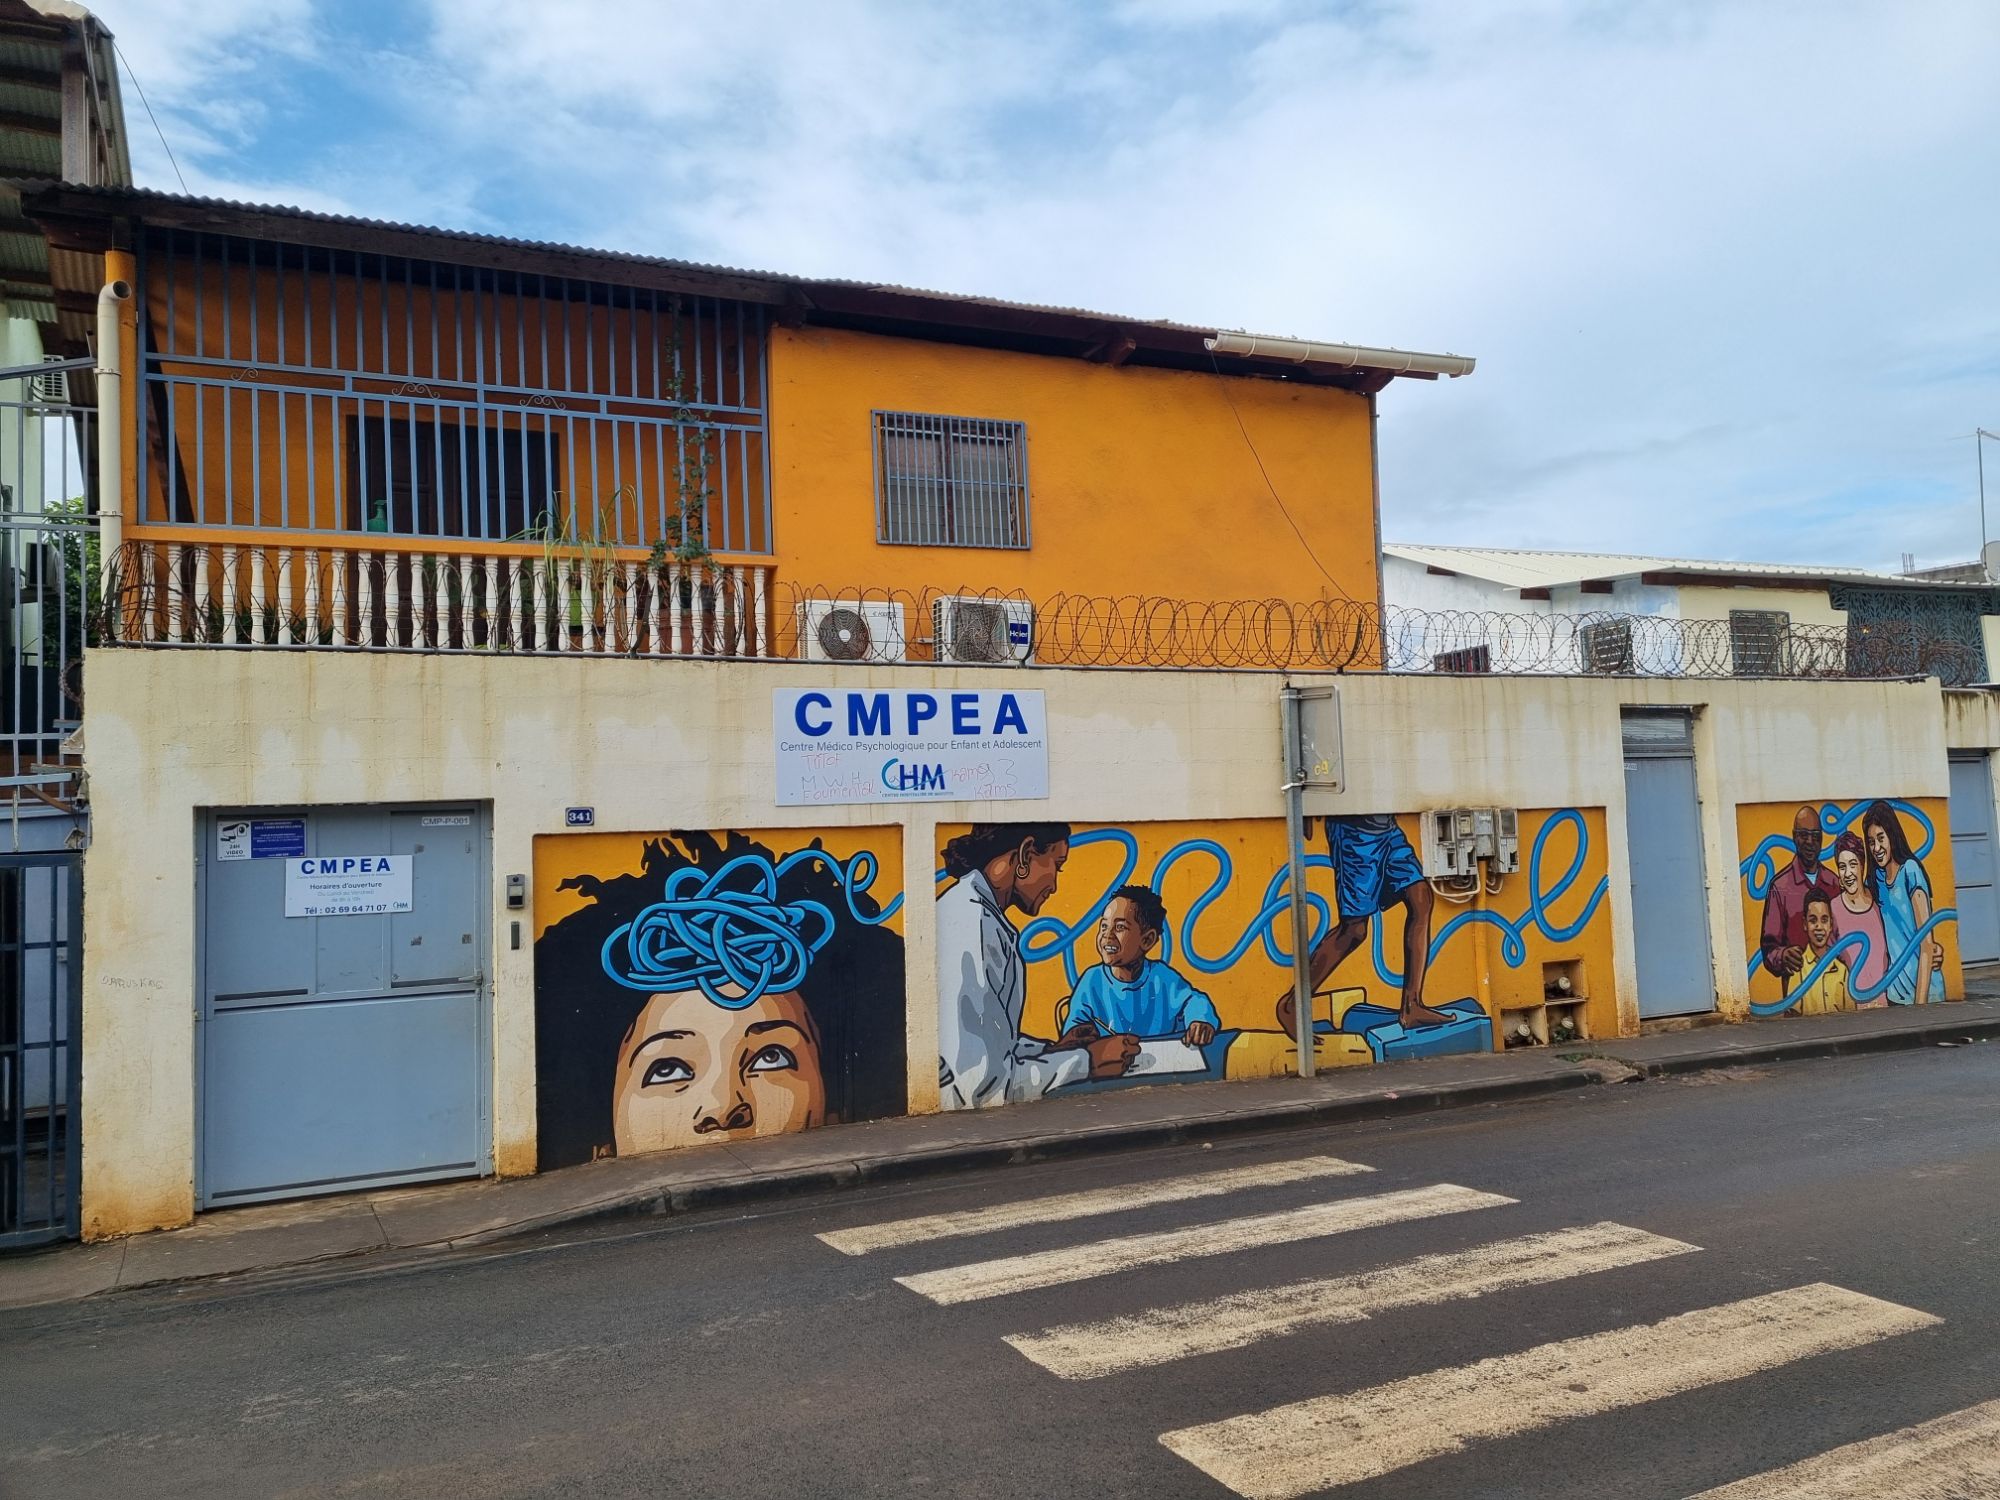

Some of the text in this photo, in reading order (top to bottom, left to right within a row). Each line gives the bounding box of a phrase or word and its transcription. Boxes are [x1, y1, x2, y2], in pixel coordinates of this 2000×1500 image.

[795, 693, 1028, 736] CMPEA
[780, 739, 1042, 753] Centre Médico Psychologique pour Enfant et Adolescent
[881, 757, 946, 791] CHM
[568, 812, 592, 822] 341
[301, 858, 390, 874] CMPEA
[342, 881, 383, 889] d'ouverture
[325, 906, 336, 914] 02
